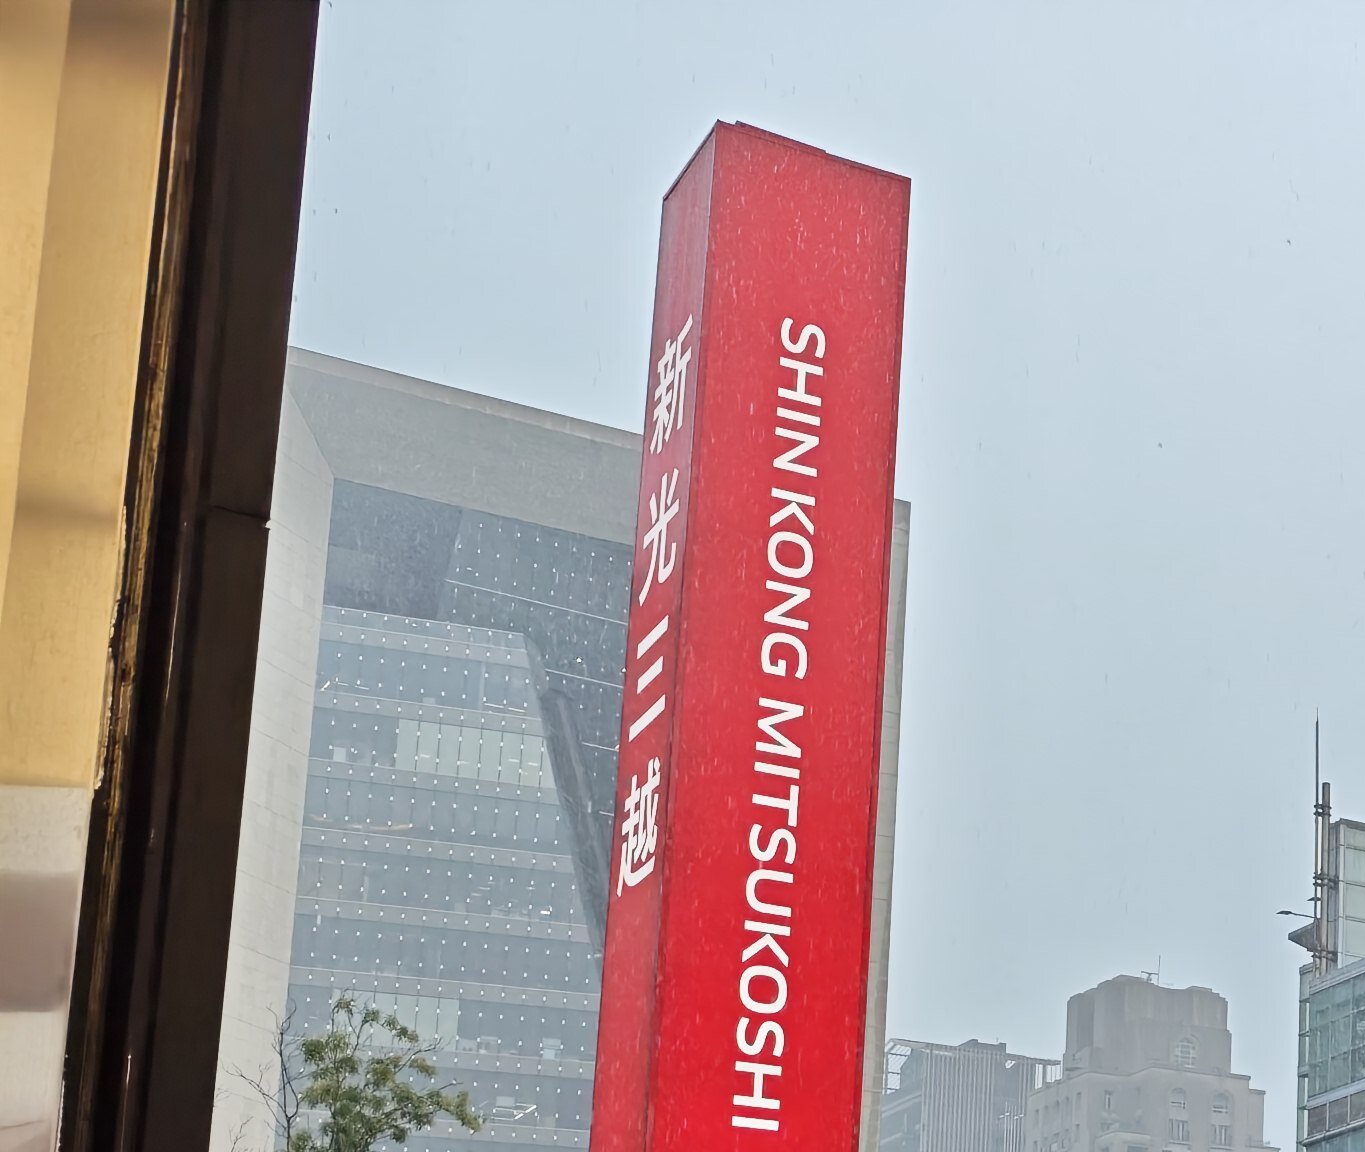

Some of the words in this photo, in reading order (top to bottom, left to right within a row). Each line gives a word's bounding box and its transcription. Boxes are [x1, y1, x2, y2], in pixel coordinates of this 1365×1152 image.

[773, 317, 827, 478] SHIN
[616, 315, 693, 898] 新光三越
[761, 487, 816, 681] KONG
[730, 697, 806, 1133] MITSUKOSHI
